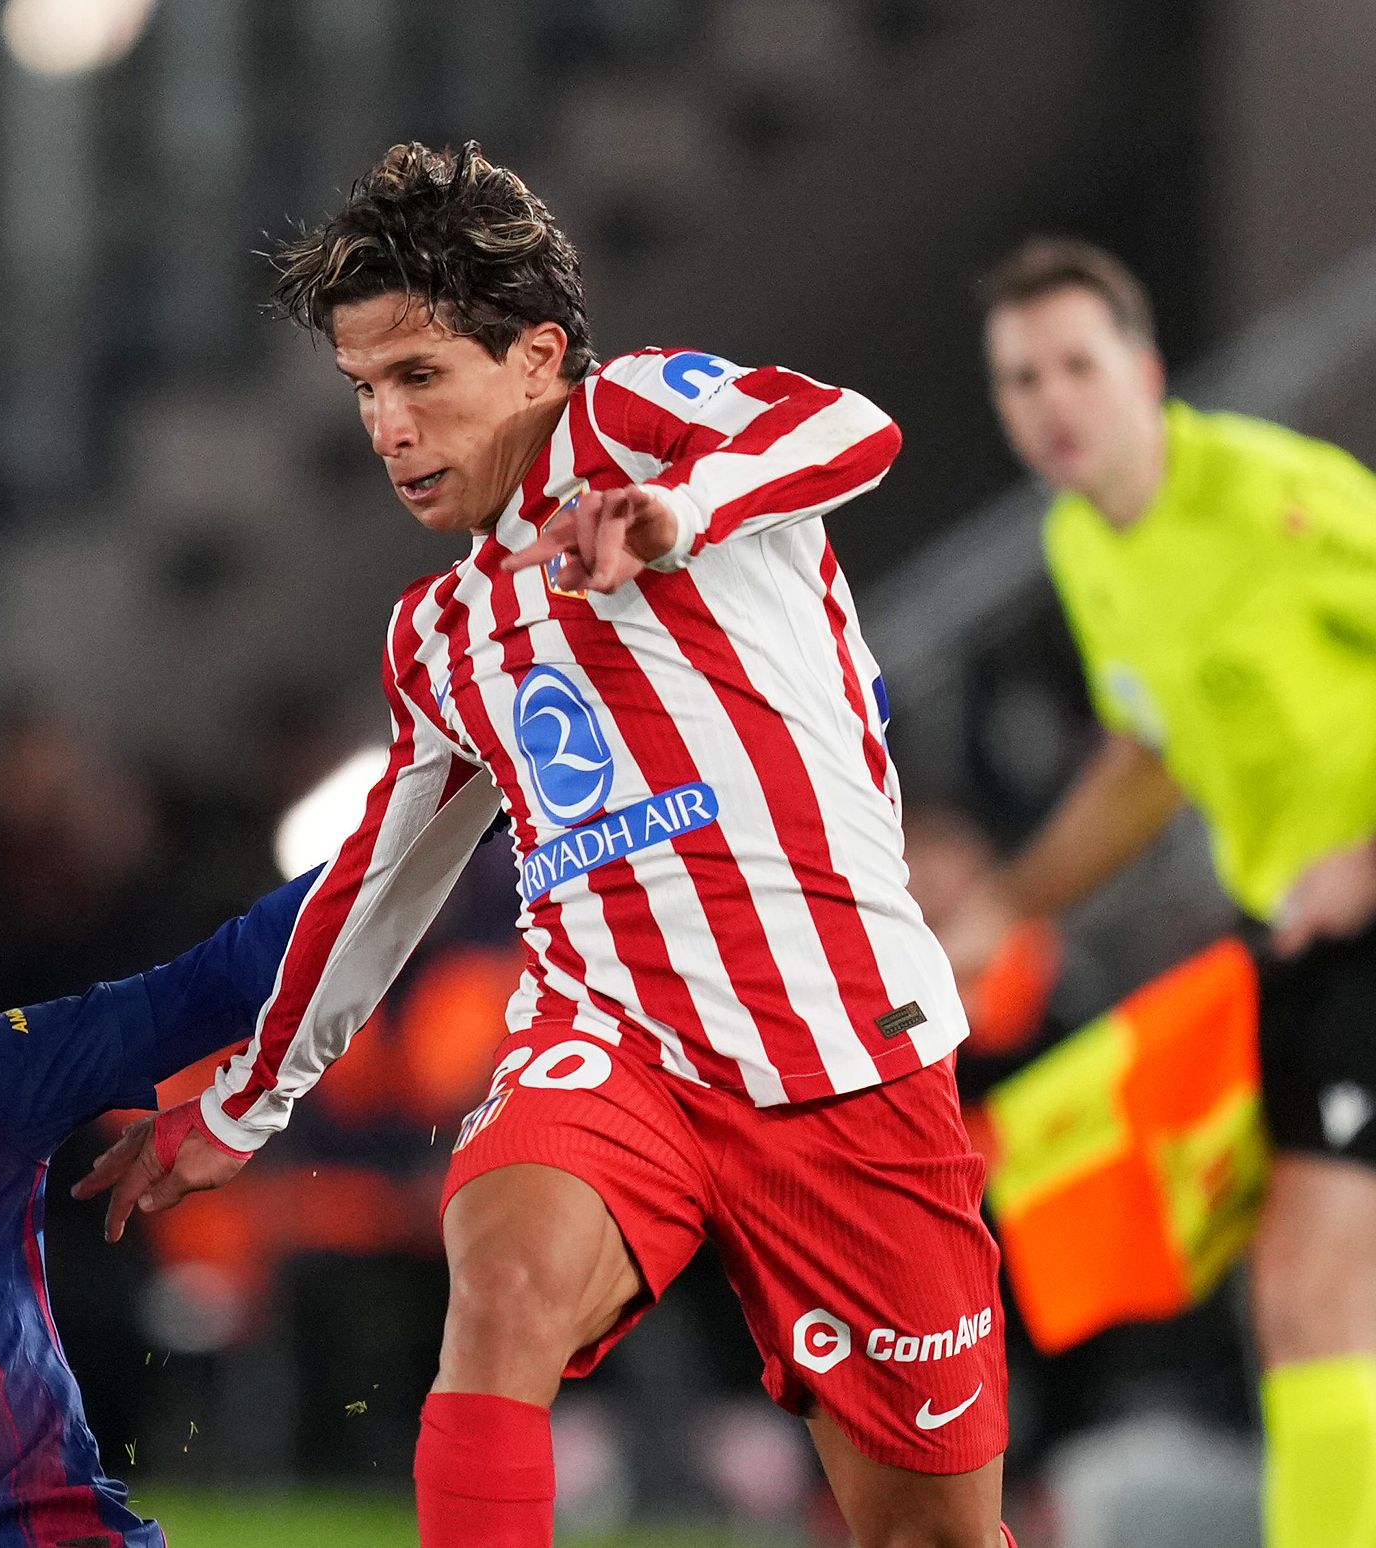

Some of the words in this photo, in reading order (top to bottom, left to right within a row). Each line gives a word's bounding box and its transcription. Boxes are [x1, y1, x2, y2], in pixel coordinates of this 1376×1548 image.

[524, 815, 634, 898] RIYADH
[644, 788, 712, 841] AIR
[865, 1306, 992, 1363] ComAve
